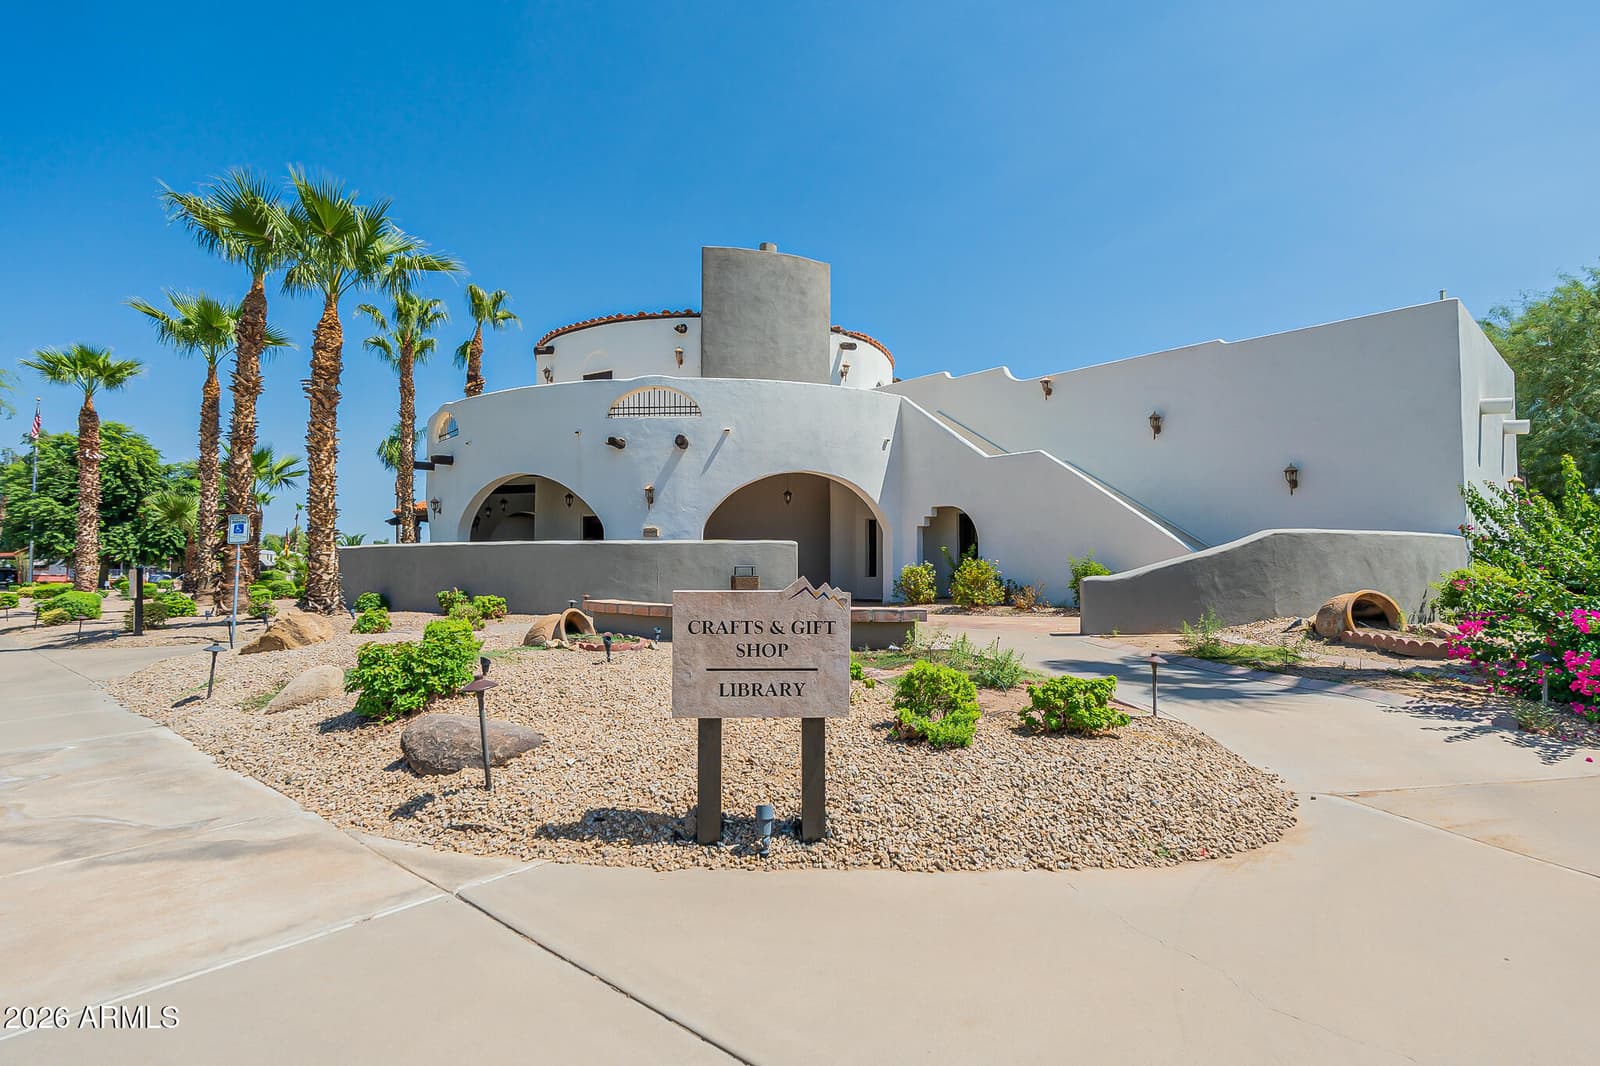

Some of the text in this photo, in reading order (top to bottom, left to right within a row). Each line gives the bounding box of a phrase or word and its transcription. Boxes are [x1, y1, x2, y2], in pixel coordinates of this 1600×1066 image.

[687, 620, 837, 635] CRAFTS & GIFT
[735, 642, 789, 658] SHOP
[718, 682, 806, 697] LIBRARY
